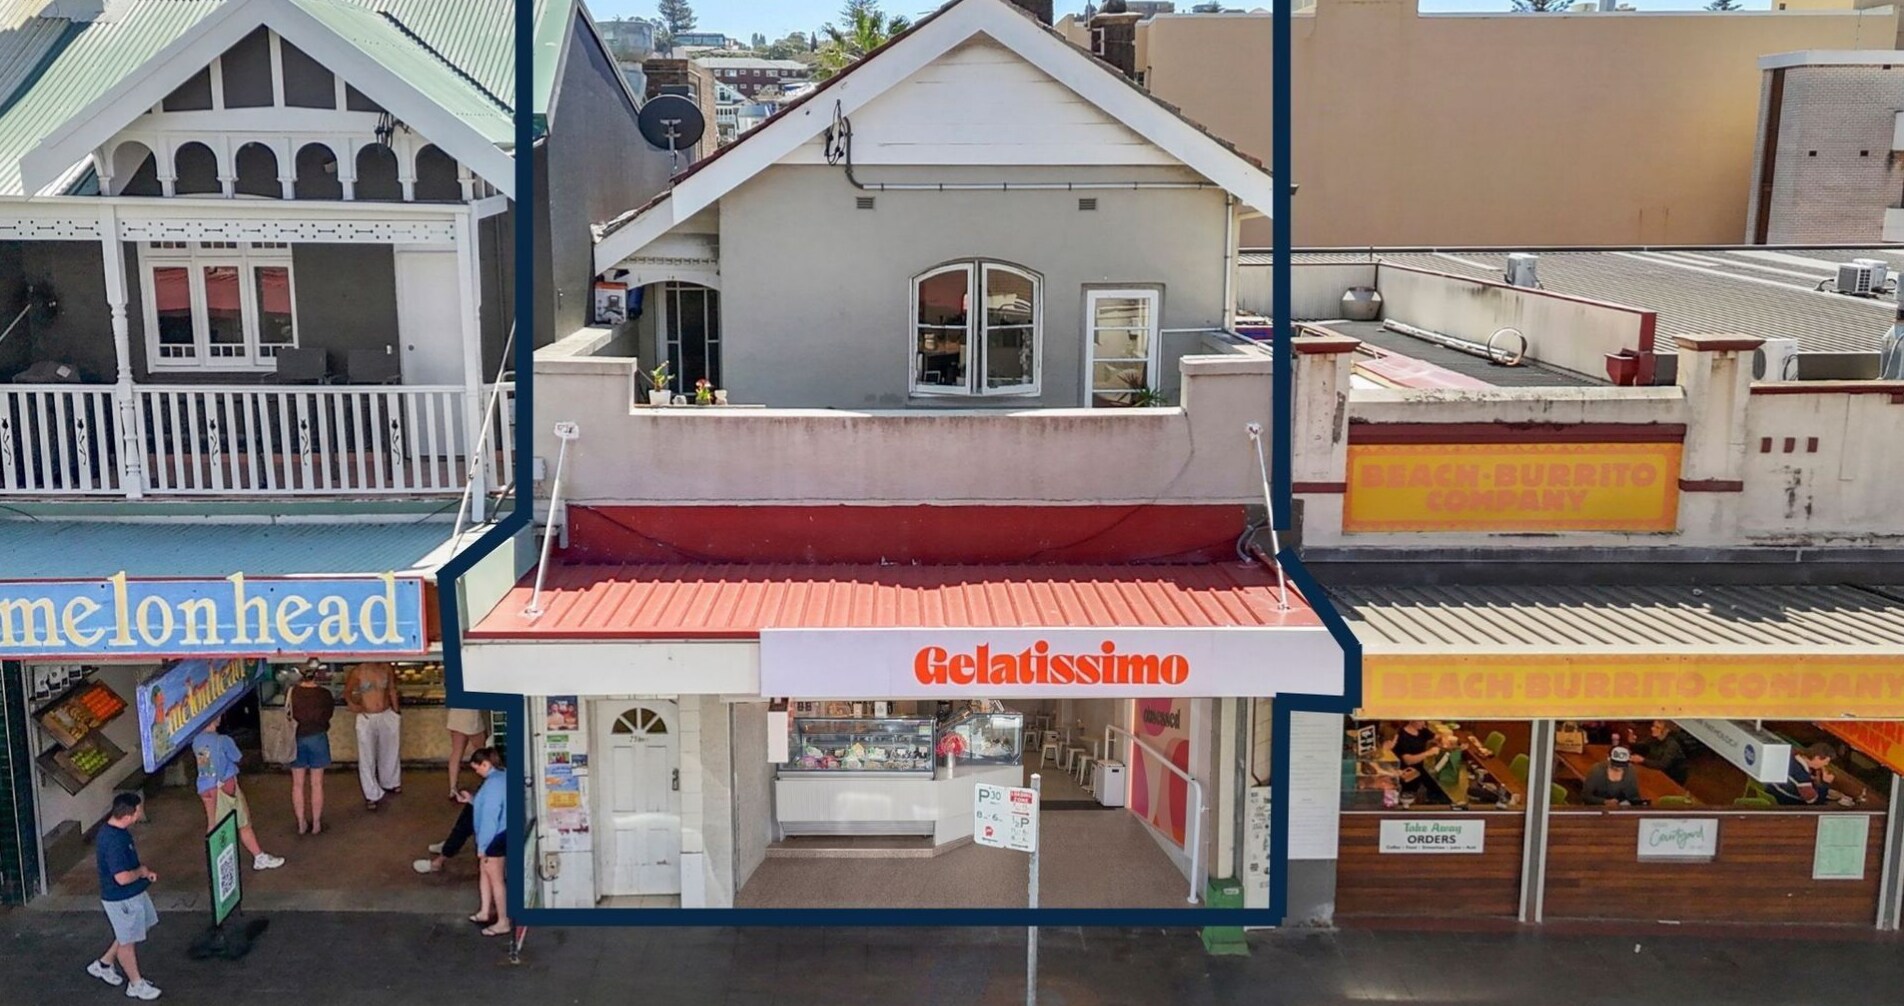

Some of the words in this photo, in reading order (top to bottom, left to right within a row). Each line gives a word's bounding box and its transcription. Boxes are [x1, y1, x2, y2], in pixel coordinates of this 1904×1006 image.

[1361, 463, 1481, 488] BEACH
[1494, 463, 1657, 488] BURRITO
[1426, 489, 1590, 512] COMPANY
[0, 570, 404, 647] melonhead
[914, 640, 1189, 685] Gelatissimo
[1382, 672, 1514, 698] BEACH
[1525, 672, 1706, 699] BURRITO
[1403, 822, 1427, 833] Take
[1431, 823, 1462, 834] Away
[1407, 834, 1456, 844] ORDERS
